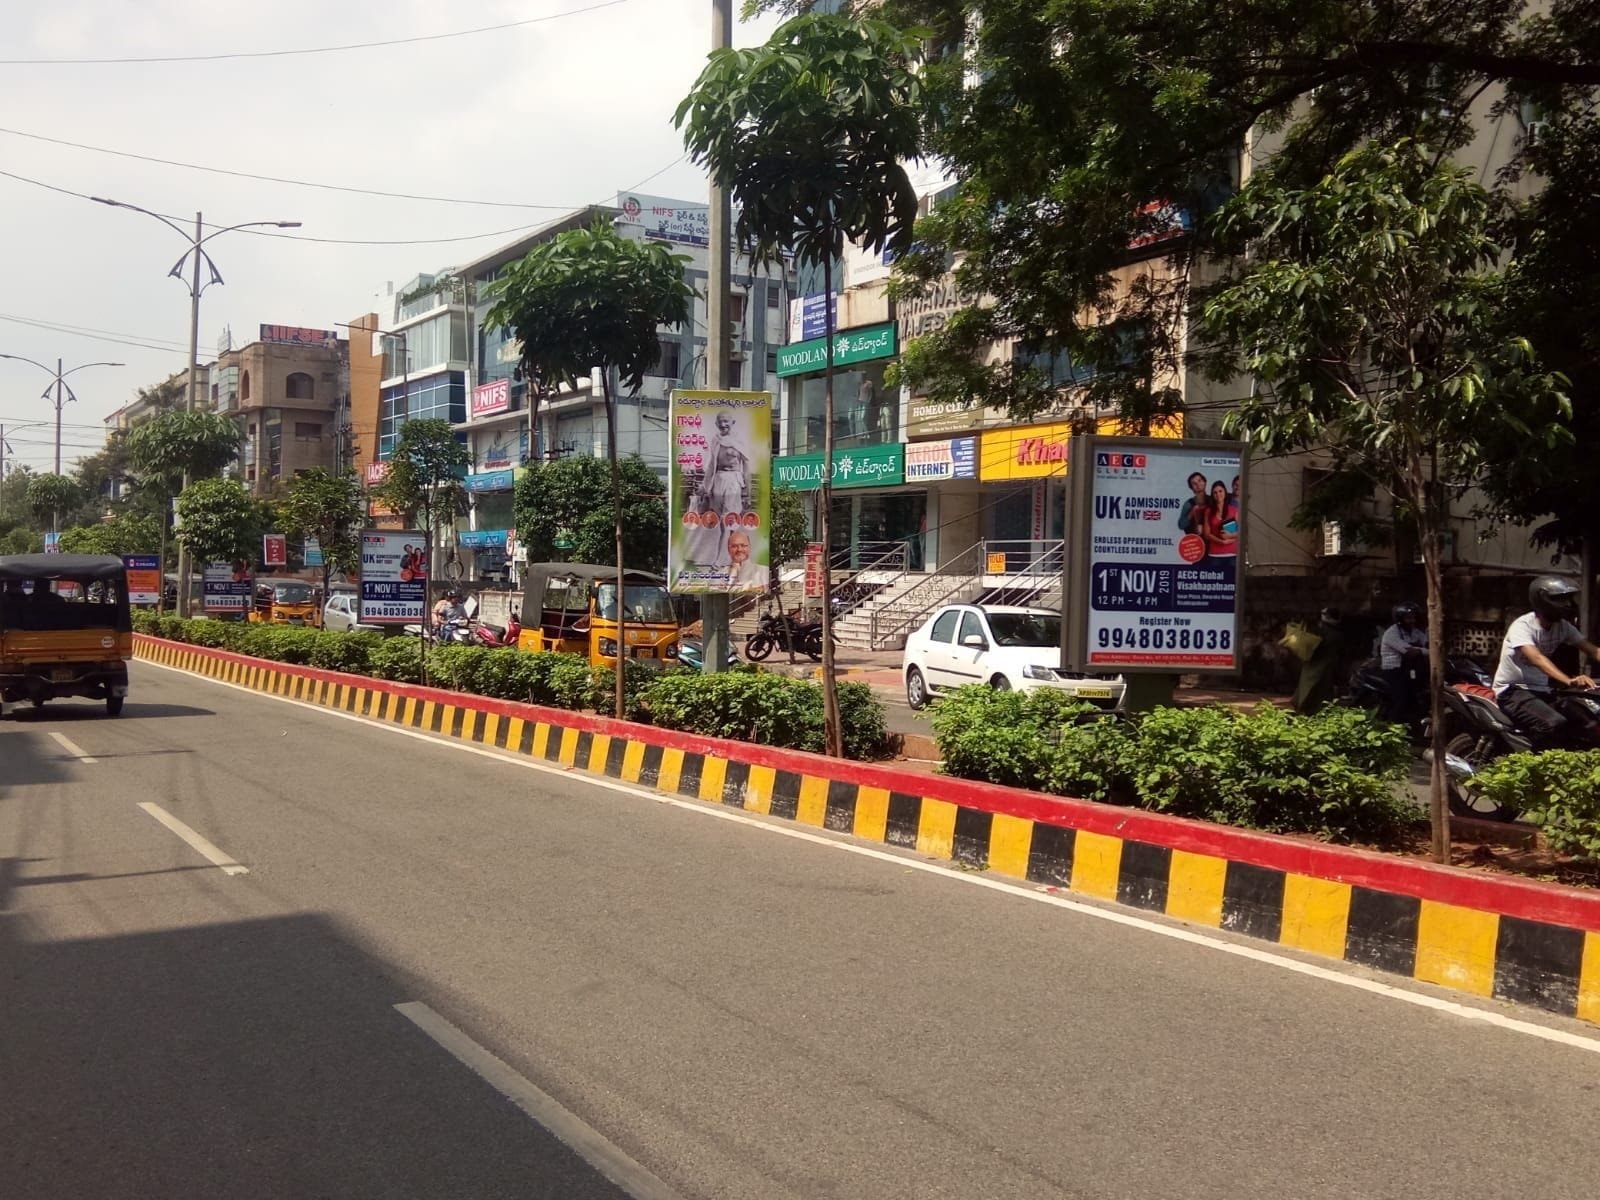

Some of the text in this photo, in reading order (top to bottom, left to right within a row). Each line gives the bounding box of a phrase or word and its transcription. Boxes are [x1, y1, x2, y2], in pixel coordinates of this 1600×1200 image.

[652, 206, 673, 218] NIFS
[480, 384, 507, 408] NIFS
[913, 404, 944, 417] HOMEO
[907, 444, 949, 464] XEROX
[1098, 454, 1146, 467] AECC
[907, 462, 949, 477] INTERNET
[1096, 467, 1146, 476] GLOBAL
[1095, 495, 1181, 520] UK ADMISSIONS
[1125, 509, 1142, 520] DAY
[1094, 535, 1122, 545] ENDLESS
[1094, 545, 1157, 555] COUNTLESS DREAMS
[1121, 569, 1157, 593] NOV
[1159, 570, 1170, 593] 2019
[1177, 570, 1224, 580] AECC Global
[374, 583, 391, 594] NOV
[1176, 581, 1236, 593] Visakhapatnam
[1097, 596, 1109, 605] 12
[1111, 596, 1125, 606] PM
[1136, 597, 1142, 606] 4
[1145, 597, 1158, 607] PM
[1139, 616, 1191, 627] Register Now
[1098, 627, 1231, 650] 9948038038
